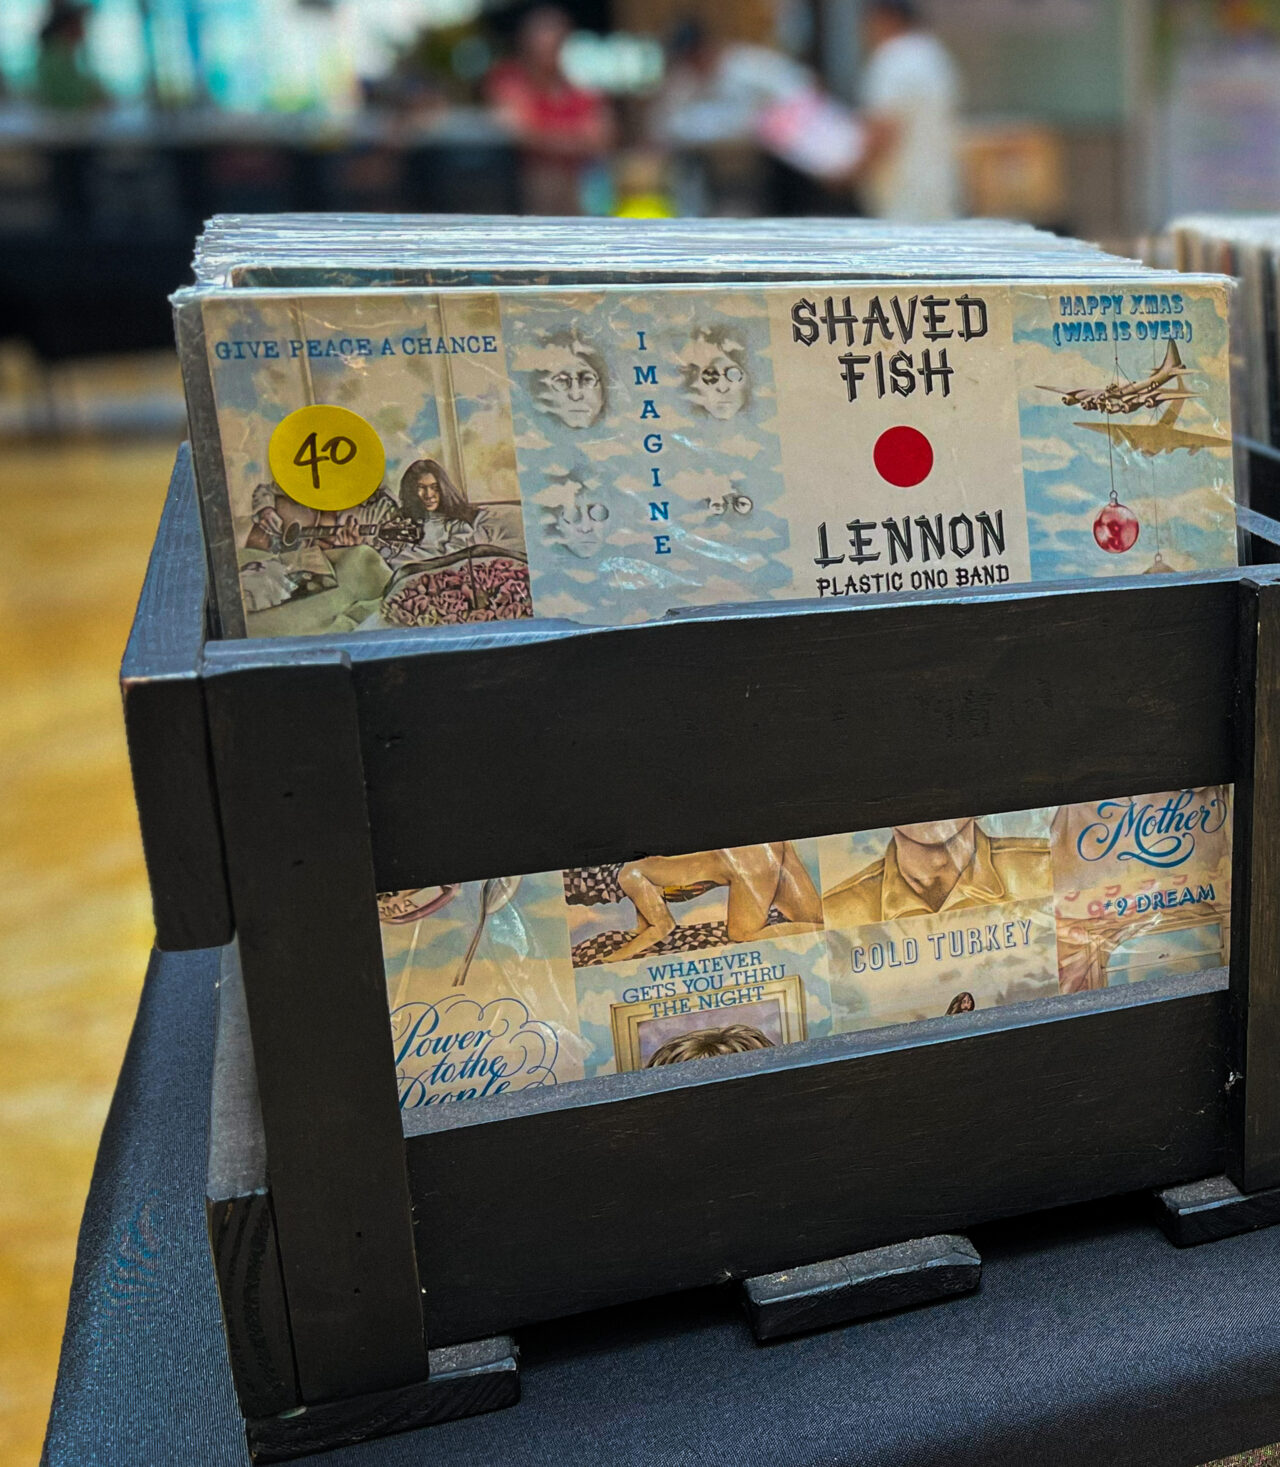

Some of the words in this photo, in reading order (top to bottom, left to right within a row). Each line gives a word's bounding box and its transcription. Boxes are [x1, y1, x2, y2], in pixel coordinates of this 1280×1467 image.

[791, 293, 989, 347] SHAVED
[1059, 295, 1124, 316] HAPPY
[1130, 294, 1184, 315] XMAS
[215, 341, 280, 360] GIVE
[290, 338, 373, 358] PEACE
[381, 337, 396, 356] A
[401, 335, 498, 356] CHANCE
[1052, 321, 1108, 346] (WAR
[1112, 320, 1132, 341] IS
[1136, 320, 1193, 343] OVER)
[837, 347, 955, 402] FISH
[293, 432, 358, 490] 40
[633, 331, 672, 555] IMAGINE
[814, 509, 1006, 569] LENNON
[816, 571, 903, 598] PLASTIC
[910, 568, 948, 590] ONO
[955, 564, 1010, 587] BAND
[1077, 789, 1227, 868] Mother
[1135, 883, 1216, 913] DREAM
[647, 950, 763, 982] WHATEVER
[850, 937, 918, 973] COLD
[928, 919, 1032, 960] TURKEY
[622, 982, 676, 1004] GETS
[682, 974, 723, 994] YOU
[730, 964, 786, 987] THRU
[648, 997, 691, 1019] THE
[698, 985, 765, 1011] NIGHT
[394, 998, 500, 1066] Power
